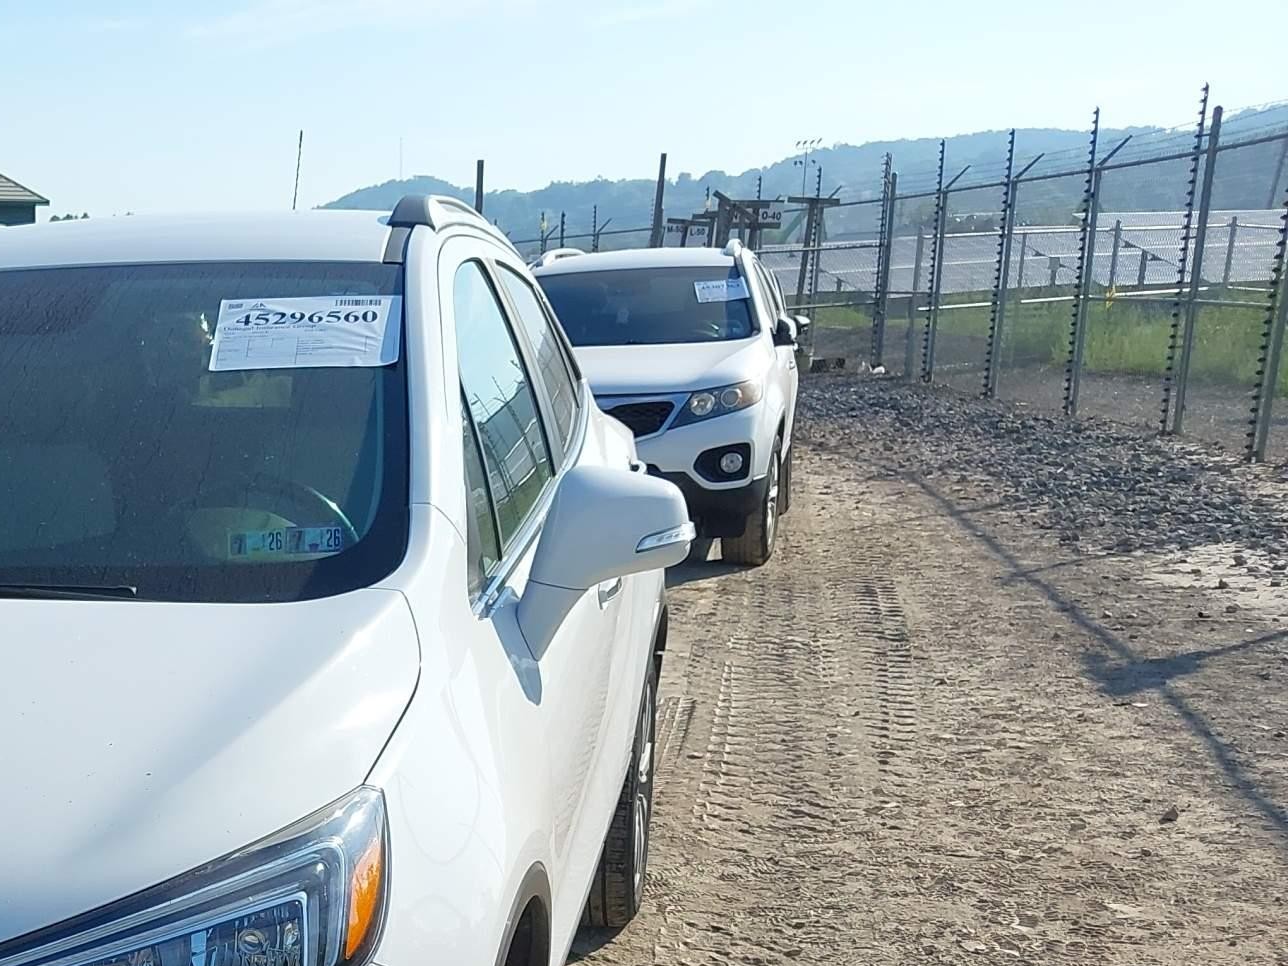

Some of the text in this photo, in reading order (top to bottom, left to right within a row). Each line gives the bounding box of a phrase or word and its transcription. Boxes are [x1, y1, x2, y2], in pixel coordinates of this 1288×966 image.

[761, 210, 782, 221] O-40
[235, 309, 379, 327] 45296560
[268, 531, 283, 552] 26
[326, 528, 341, 549] 26
